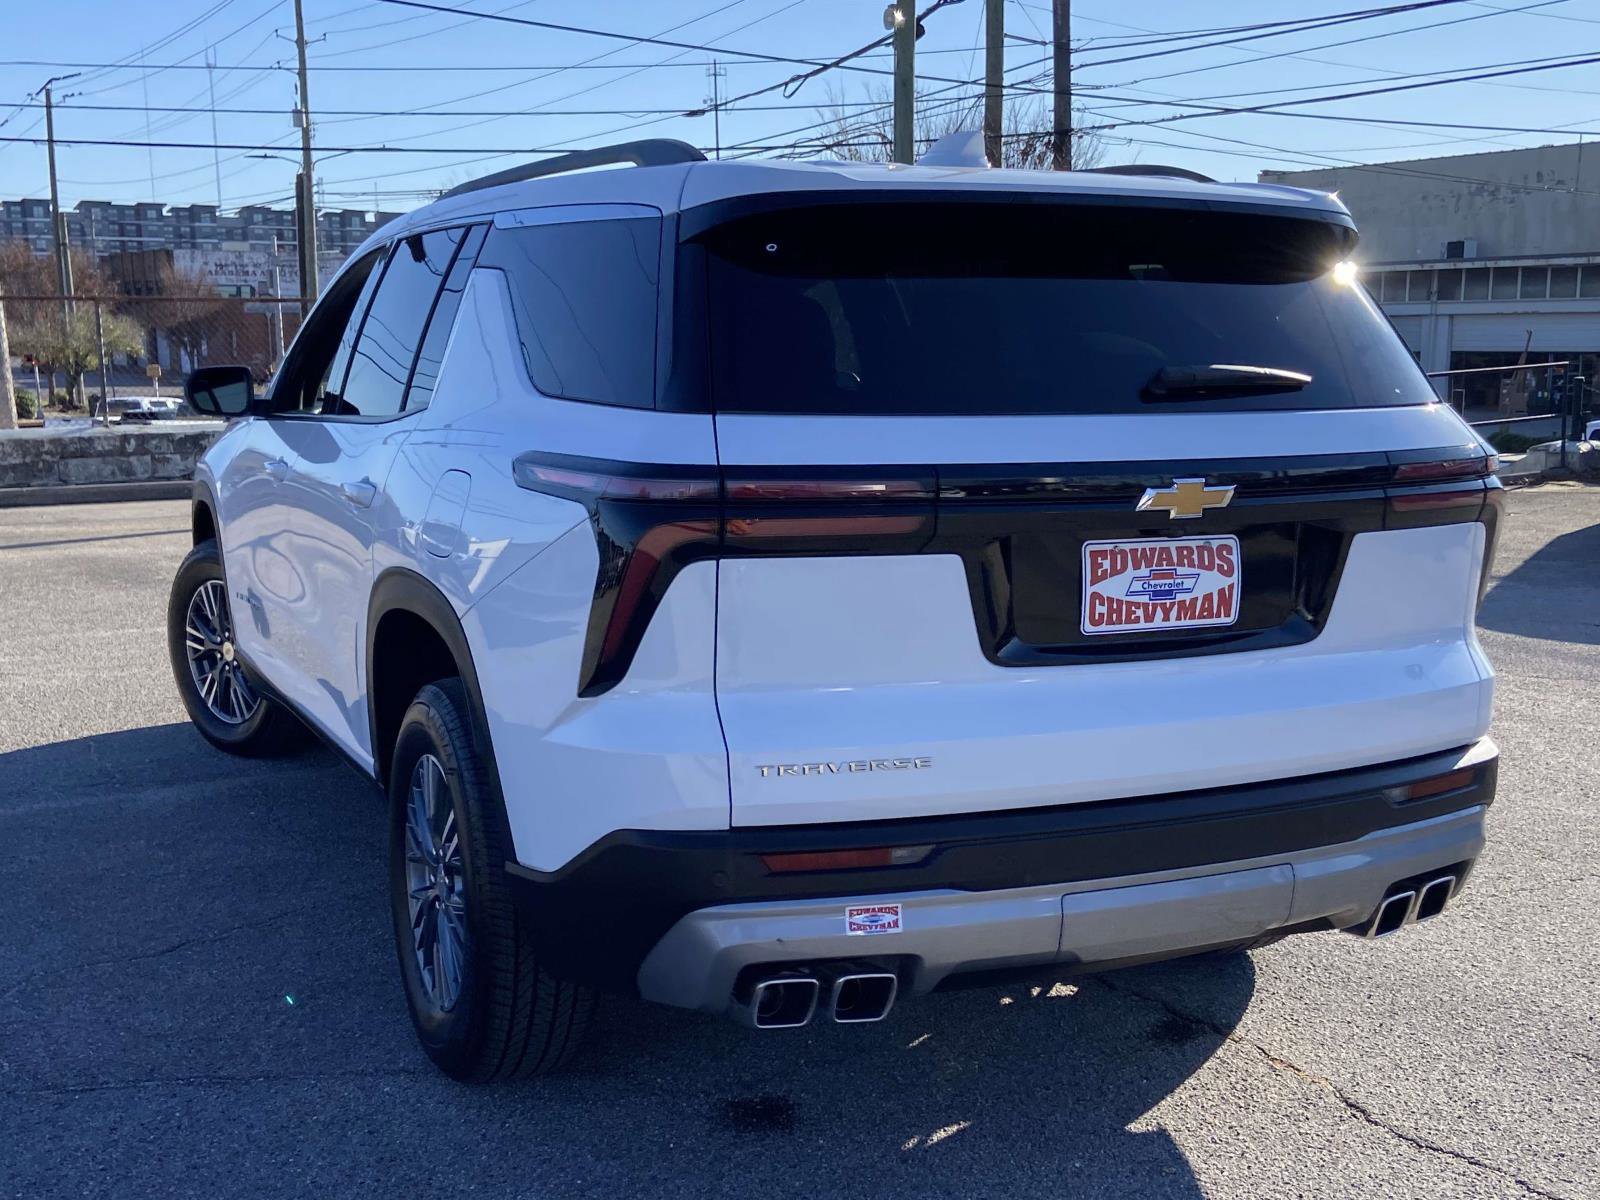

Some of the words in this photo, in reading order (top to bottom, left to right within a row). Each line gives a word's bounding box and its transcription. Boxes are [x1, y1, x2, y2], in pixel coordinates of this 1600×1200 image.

[1089, 543, 1235, 587] EDWARDS
[1141, 580, 1185, 590] Chevrolet
[1089, 582, 1235, 627] CHEVYMAN
[754, 756, 935, 777] TRAVERSE
